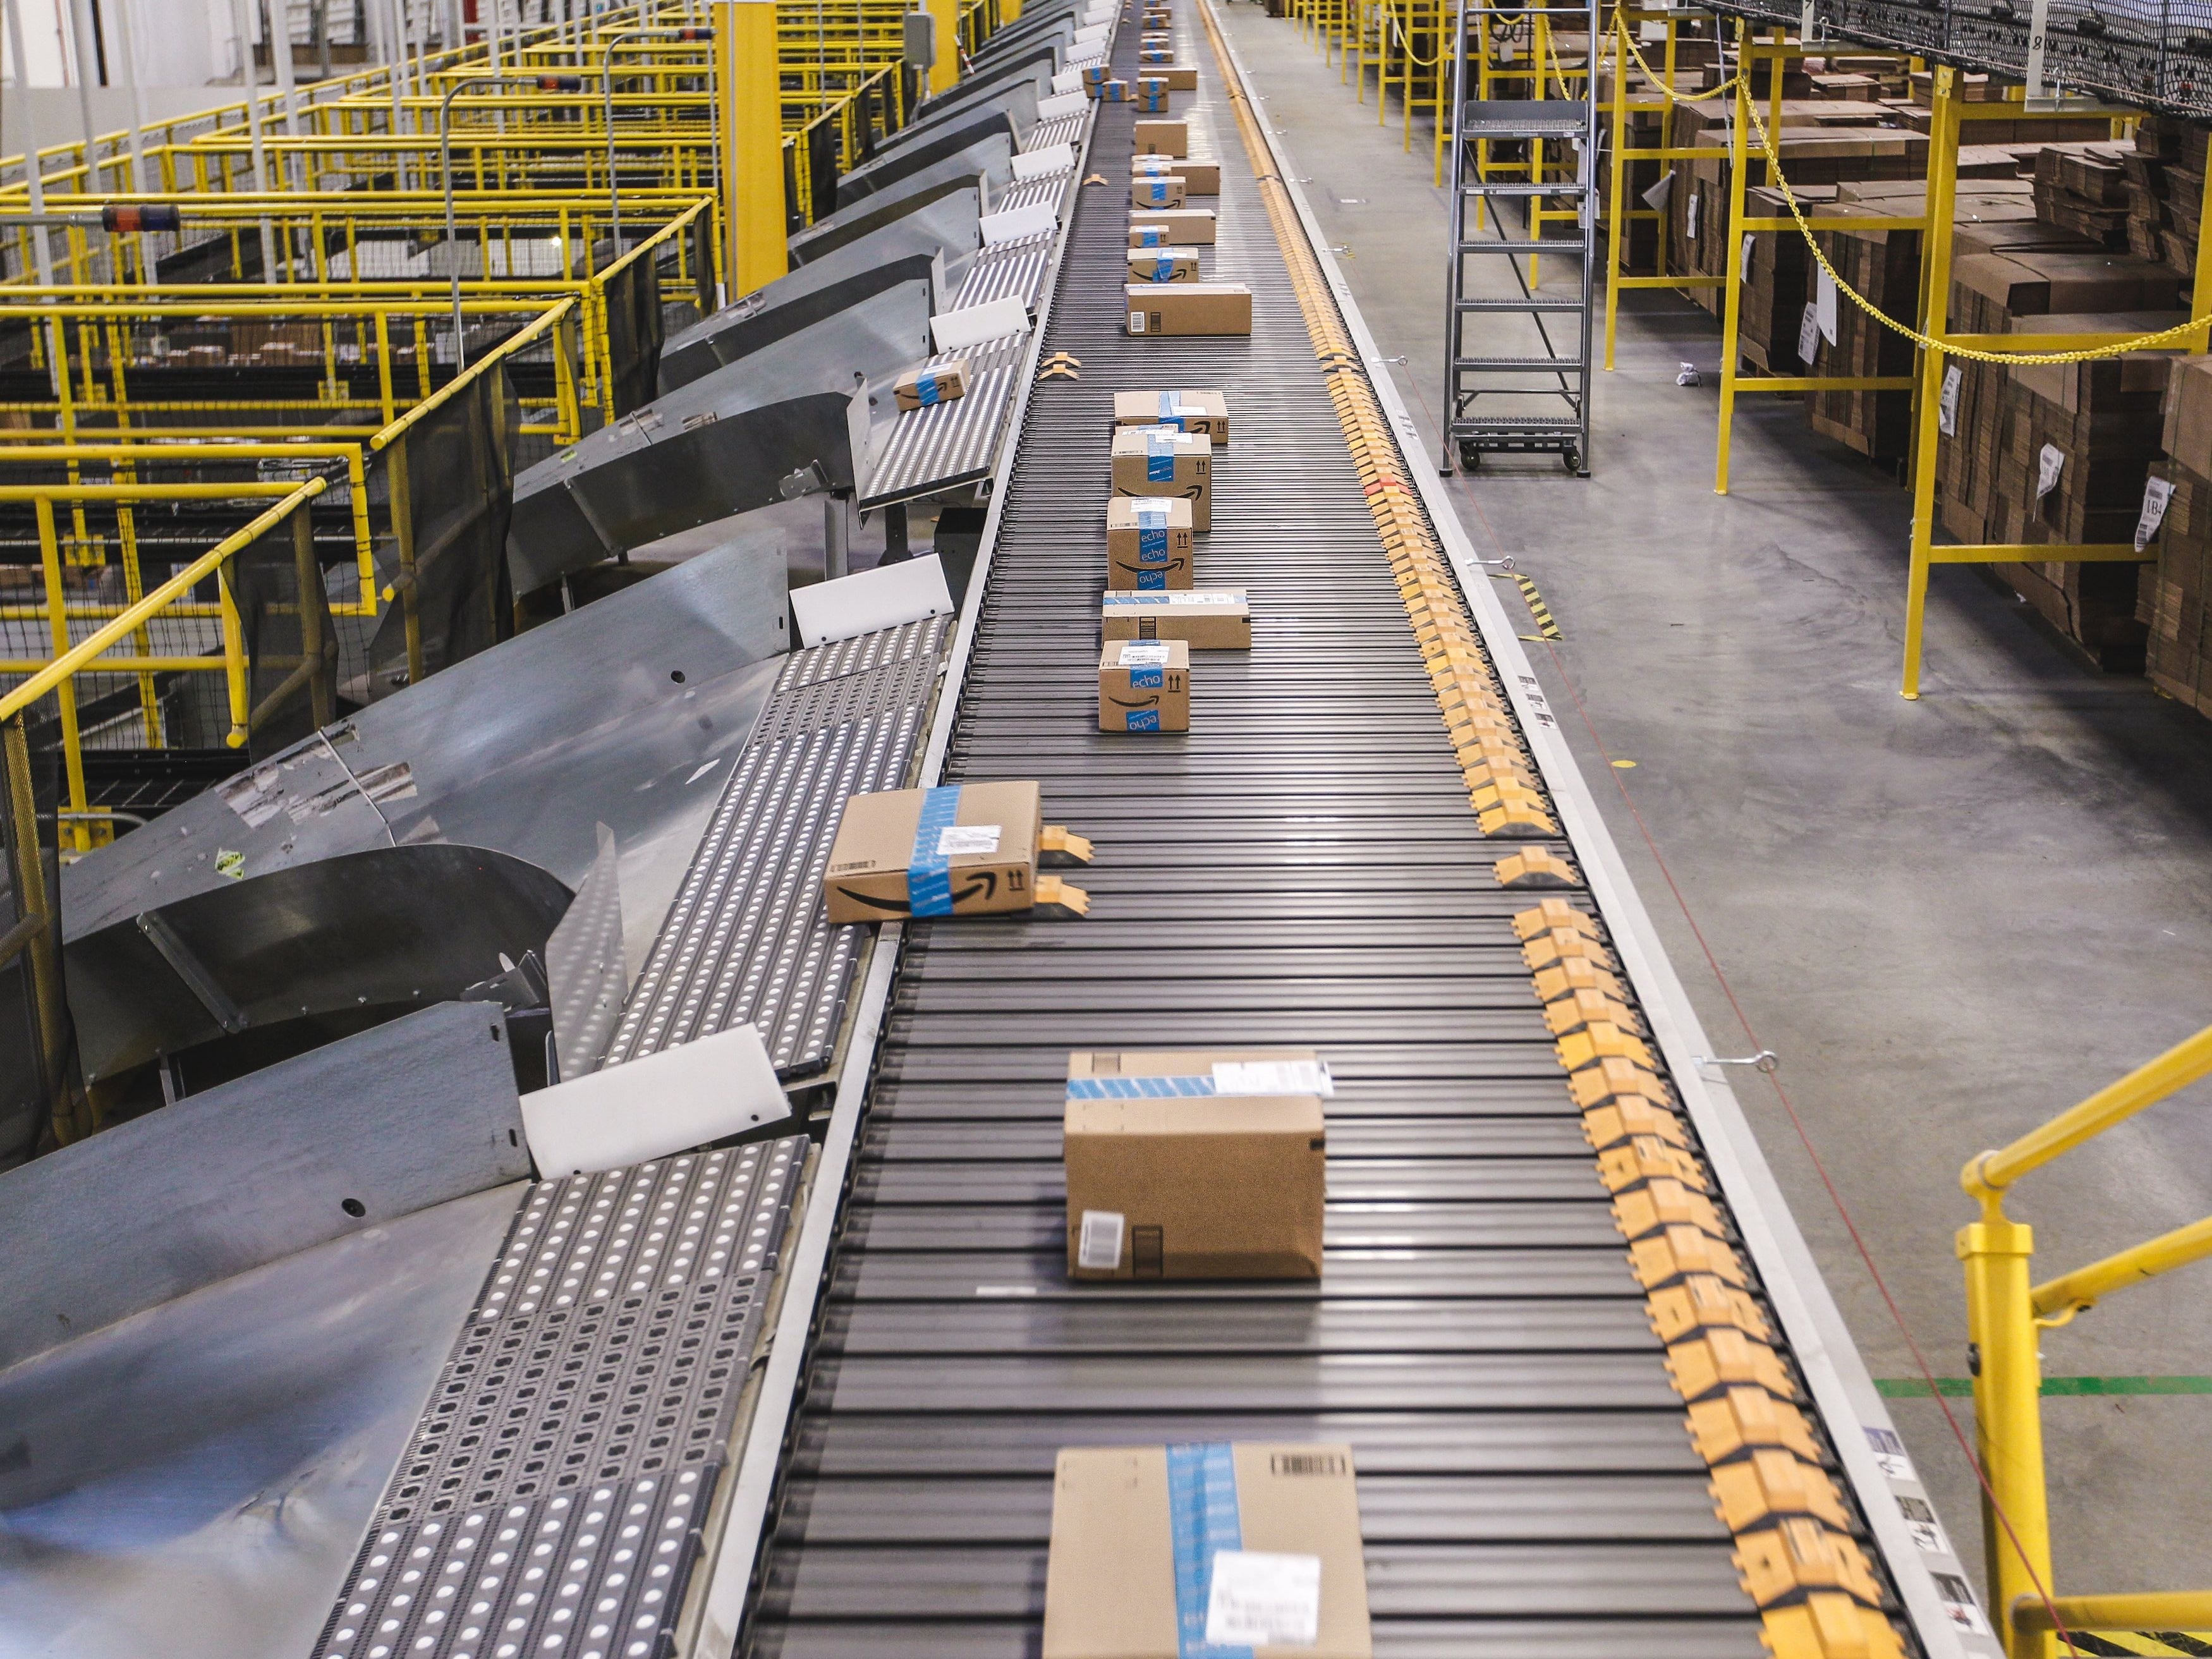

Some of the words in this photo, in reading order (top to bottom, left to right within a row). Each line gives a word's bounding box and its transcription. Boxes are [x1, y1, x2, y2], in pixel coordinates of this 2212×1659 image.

[2033, 35, 2042, 50] 8
[1141, 530, 1165, 542] echo
[1141, 549, 1165, 561] echo
[1139, 571, 1163, 583] echo
[1132, 675, 1160, 688] echo
[1129, 715, 1157, 730] echo
